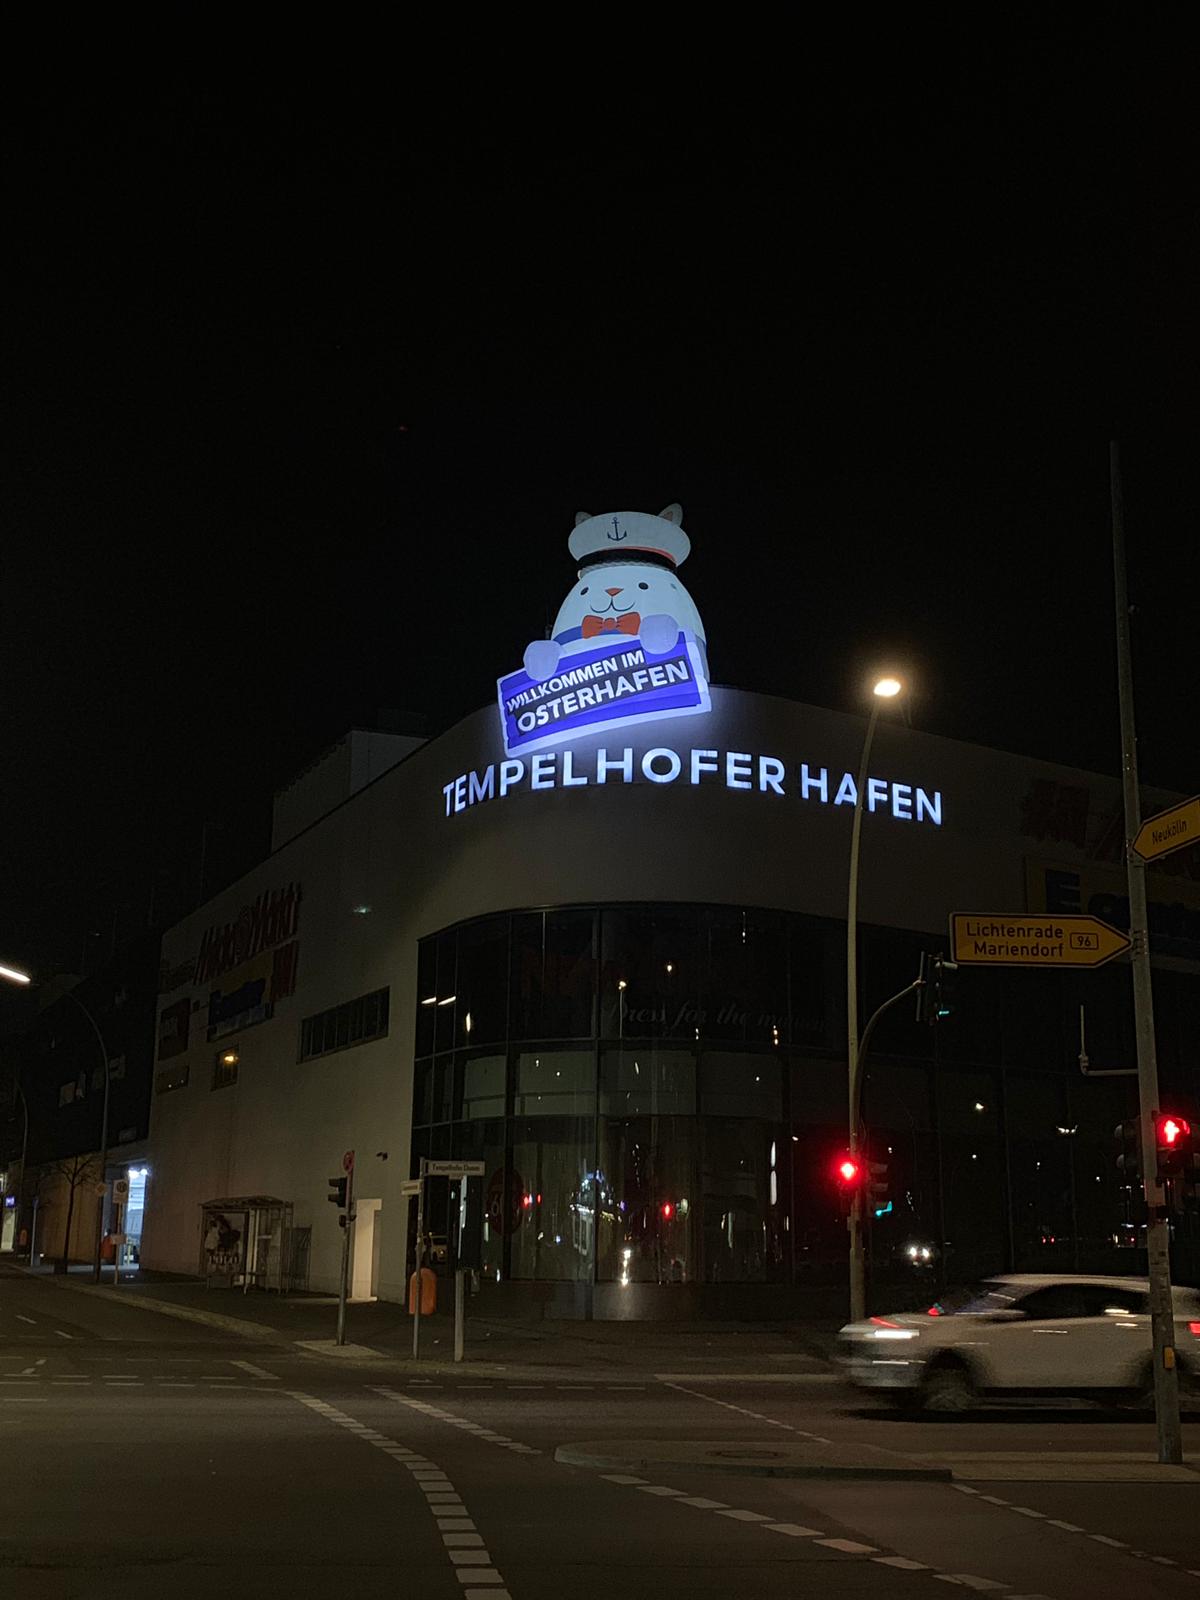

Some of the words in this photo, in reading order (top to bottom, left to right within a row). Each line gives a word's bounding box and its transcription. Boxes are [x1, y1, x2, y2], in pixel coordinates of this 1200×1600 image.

[506, 656, 617, 712] WILLKOMMEN
[621, 650, 645, 668] IM
[517, 660, 689, 732] OSTERHAFEN
[442, 747, 786, 817] TEMPELHOFER
[801, 763, 942, 825] HAFEN
[1152, 819, 1187, 845] Neukölln
[966, 922, 1063, 938] Lichtenrade
[1077, 935, 1091, 947] 96
[974, 941, 1065, 957] Mariendorf
